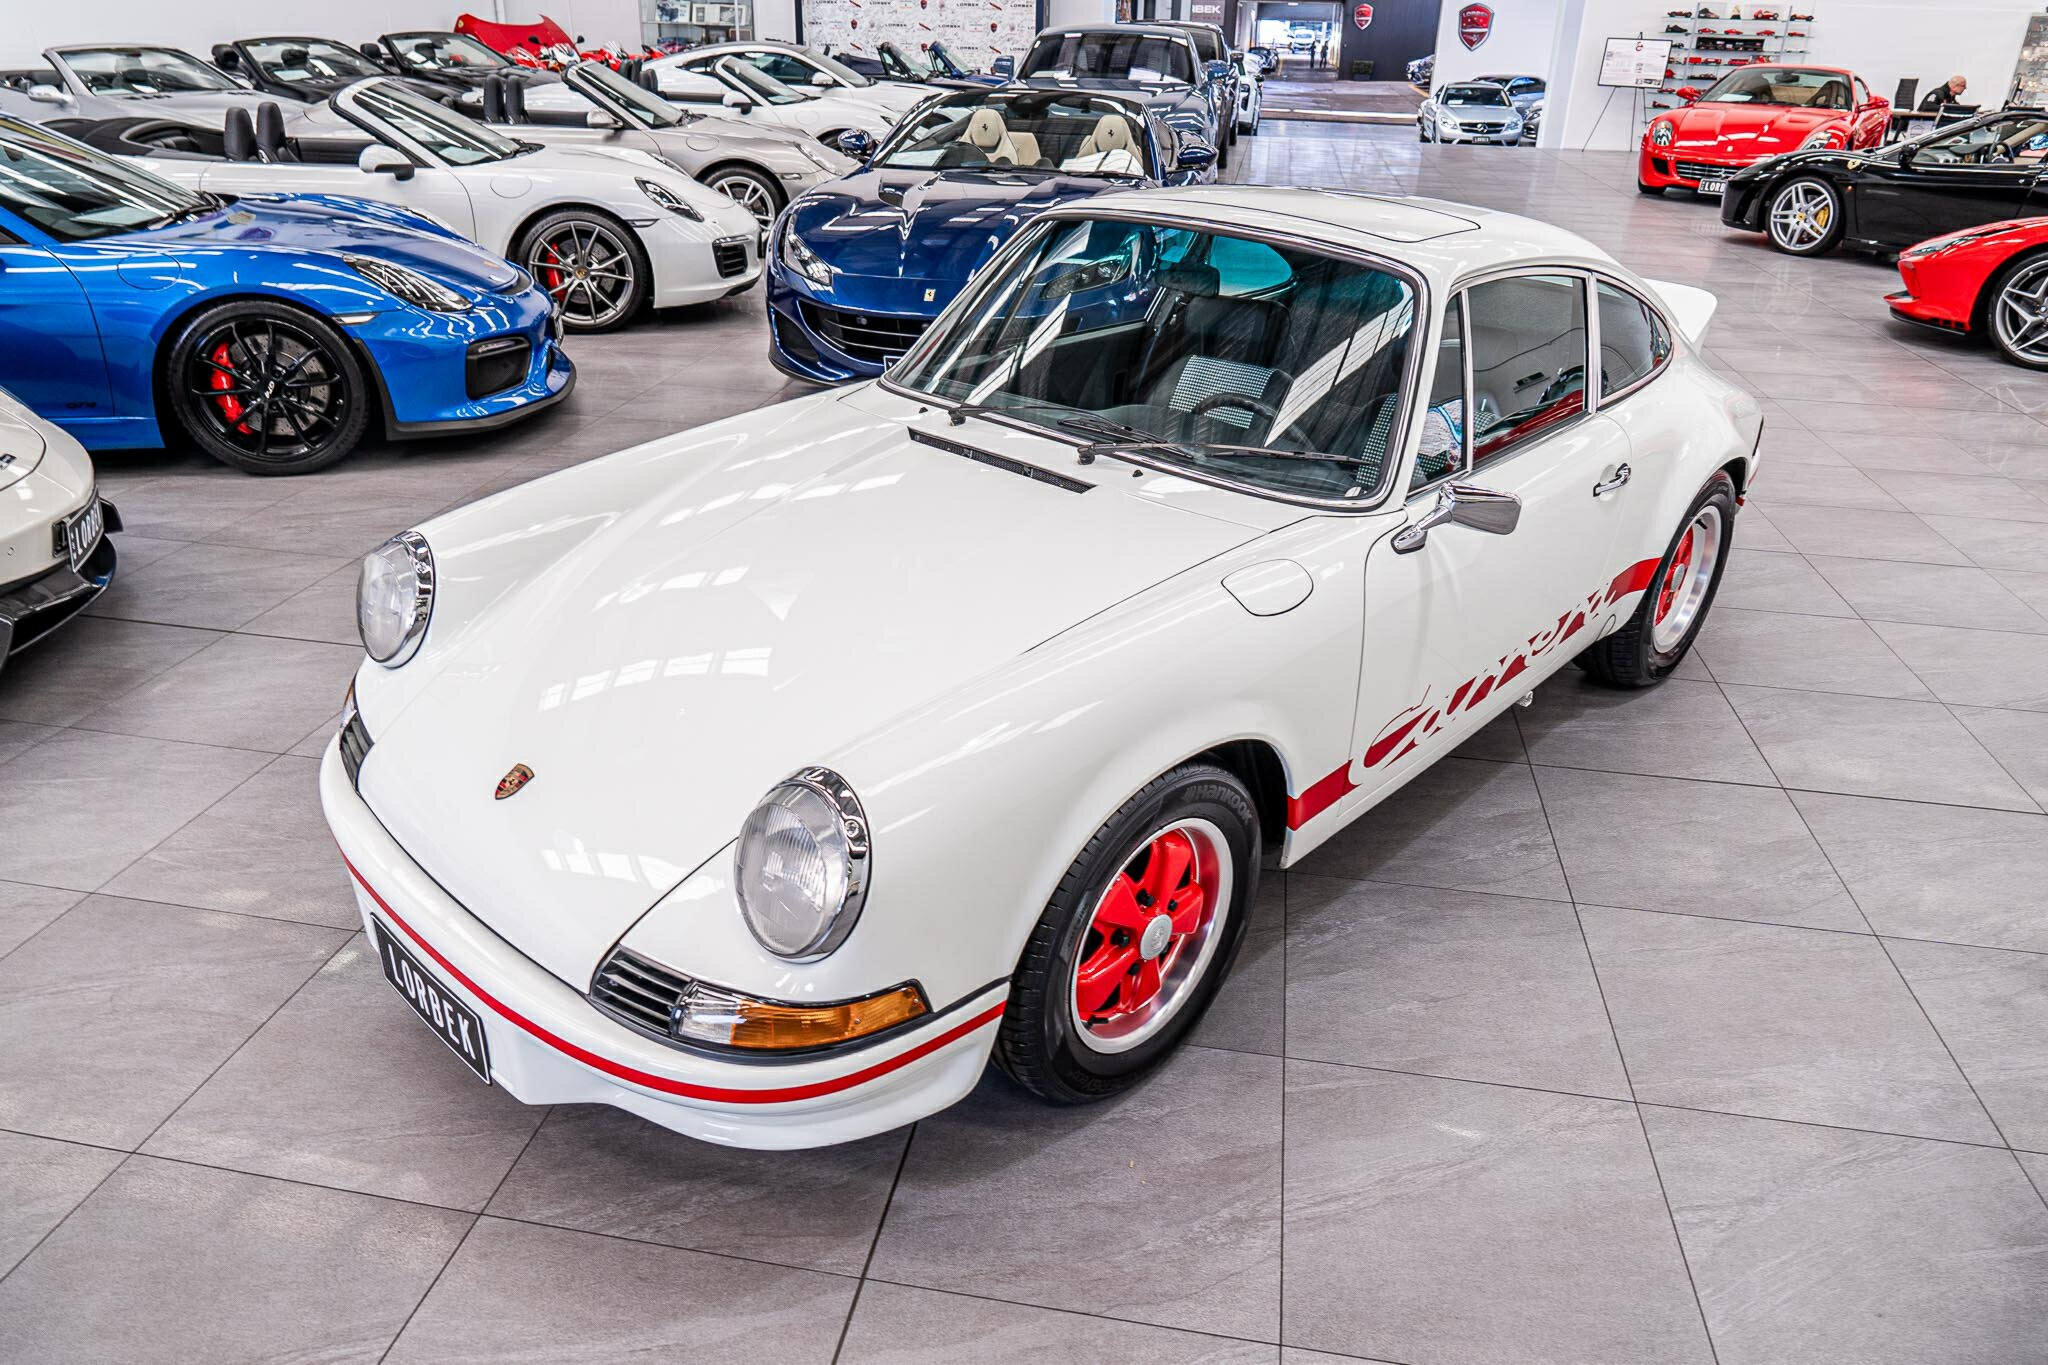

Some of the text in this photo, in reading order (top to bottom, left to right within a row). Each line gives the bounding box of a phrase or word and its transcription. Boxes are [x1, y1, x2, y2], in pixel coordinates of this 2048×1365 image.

[1192, 4, 1221, 14] BEK
[1705, 182, 1726, 192] LORB
[388, 944, 476, 1060] LORBEK
